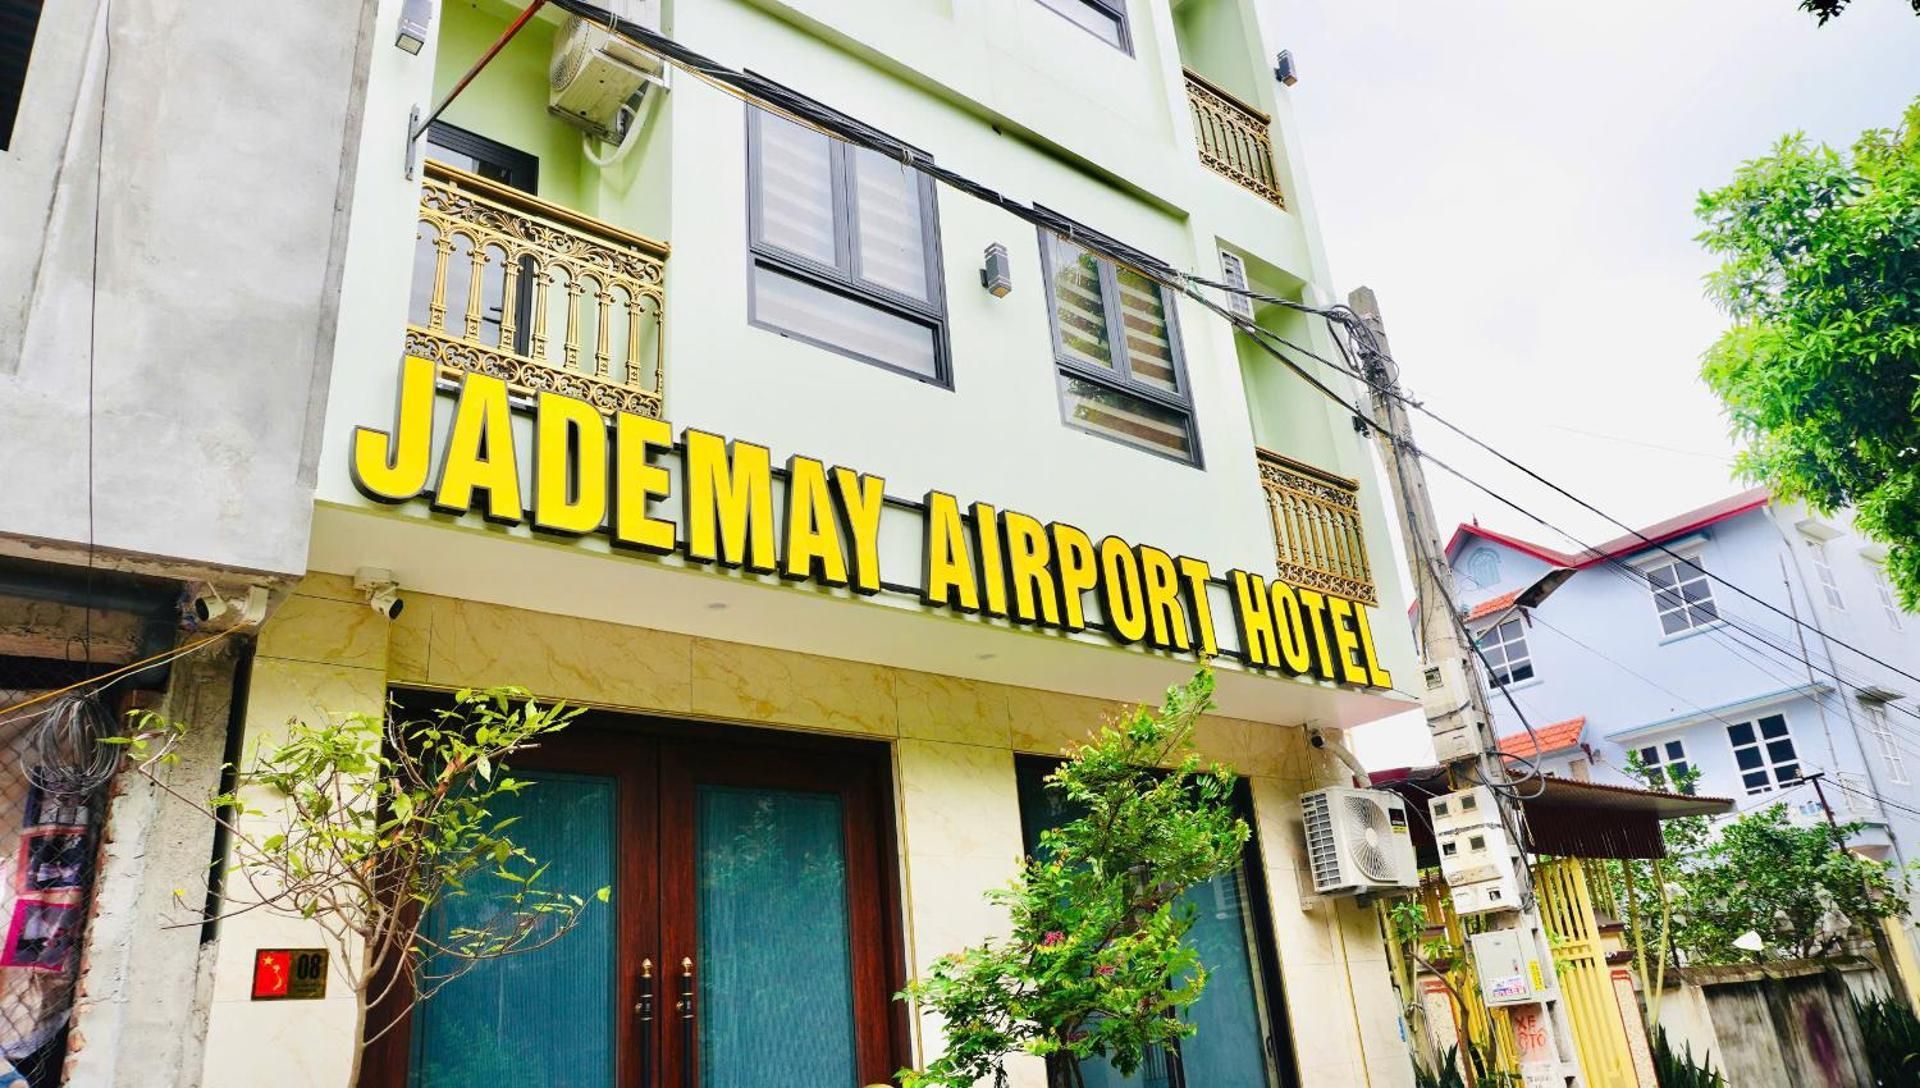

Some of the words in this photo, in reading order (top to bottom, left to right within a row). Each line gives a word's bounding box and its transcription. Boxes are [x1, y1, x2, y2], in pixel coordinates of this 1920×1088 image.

[350, 354, 885, 595] JADEMAY
[921, 490, 1218, 656] AIRPORT
[1227, 569, 1392, 689] HOTEL
[297, 953, 321, 979] 08
